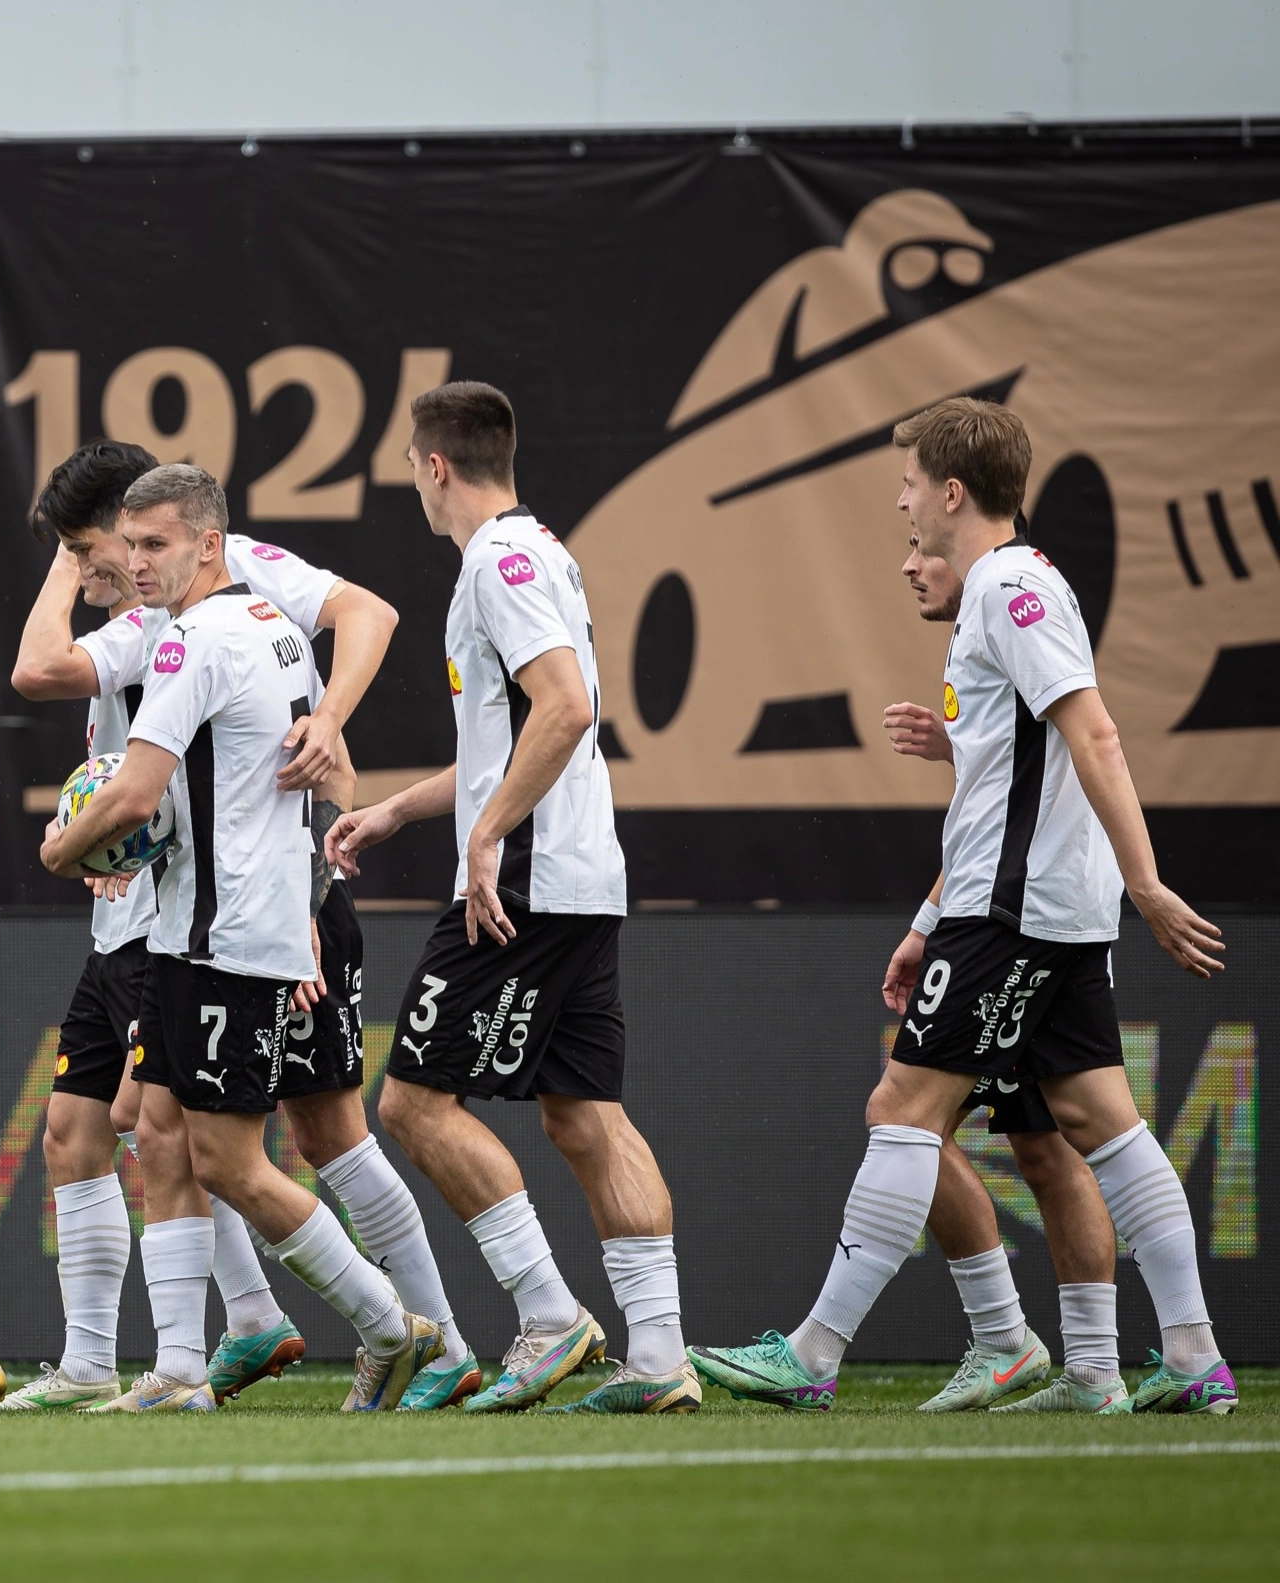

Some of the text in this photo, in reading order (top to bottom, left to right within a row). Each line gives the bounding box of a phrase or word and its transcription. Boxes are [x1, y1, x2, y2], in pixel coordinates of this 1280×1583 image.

[501, 559, 532, 579] wb
[1012, 599, 1041, 621] wb
[156, 648, 183, 665] wb
[409, 974, 448, 1033] 3
[917, 959, 951, 1015] 9
[996, 969, 1052, 1049] Cola
[200, 1005, 227, 1061] 7
[267, 986, 288, 1093] ЧЕРНОГОЛОВКА
[470, 977, 519, 1077] ЧЕРНОГОЛОВКА
[492, 989, 539, 1075] Cola
